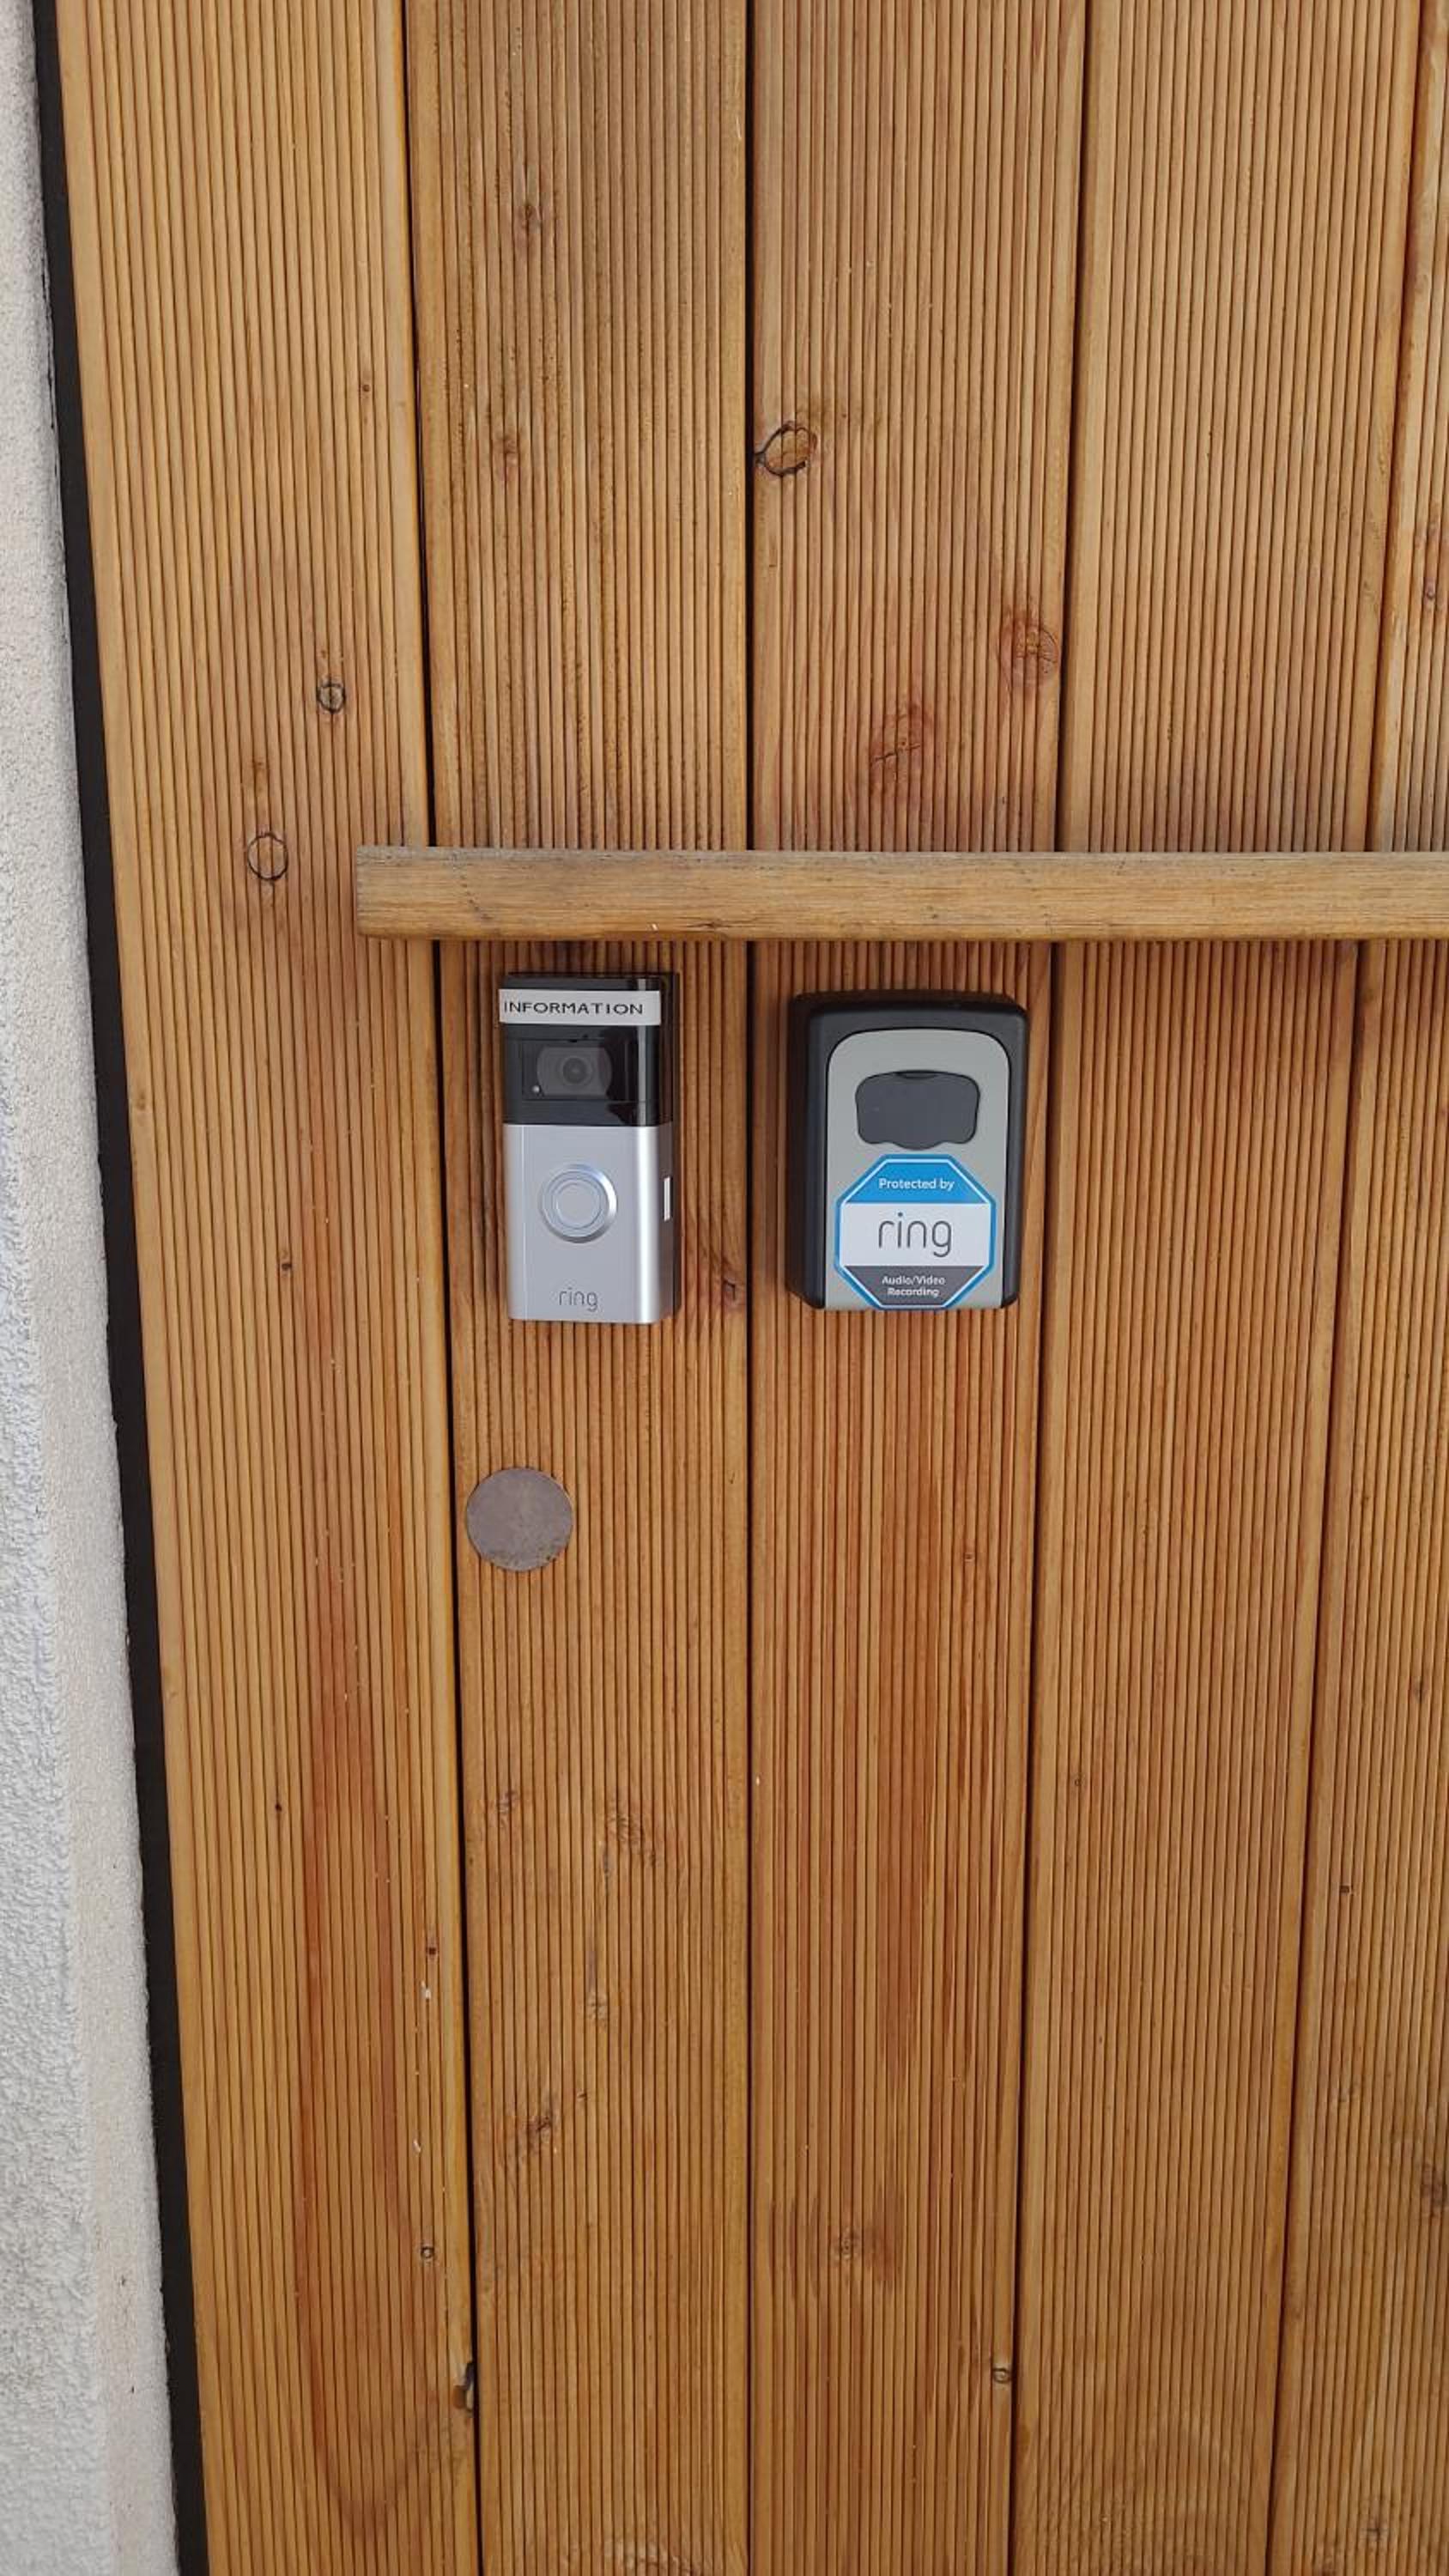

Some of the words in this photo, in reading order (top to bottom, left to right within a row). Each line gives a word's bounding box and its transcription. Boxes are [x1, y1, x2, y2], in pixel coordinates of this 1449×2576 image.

[504, 1000, 643, 1015] INFORMATION
[878, 1177, 936, 1190] Protected
[939, 1177, 955, 1192] by
[878, 1212, 952, 1258] ring
[882, 1275, 945, 1286] Audio/Video
[559, 1286, 598, 1312] ring
[887, 1287, 940, 1297] Recording
